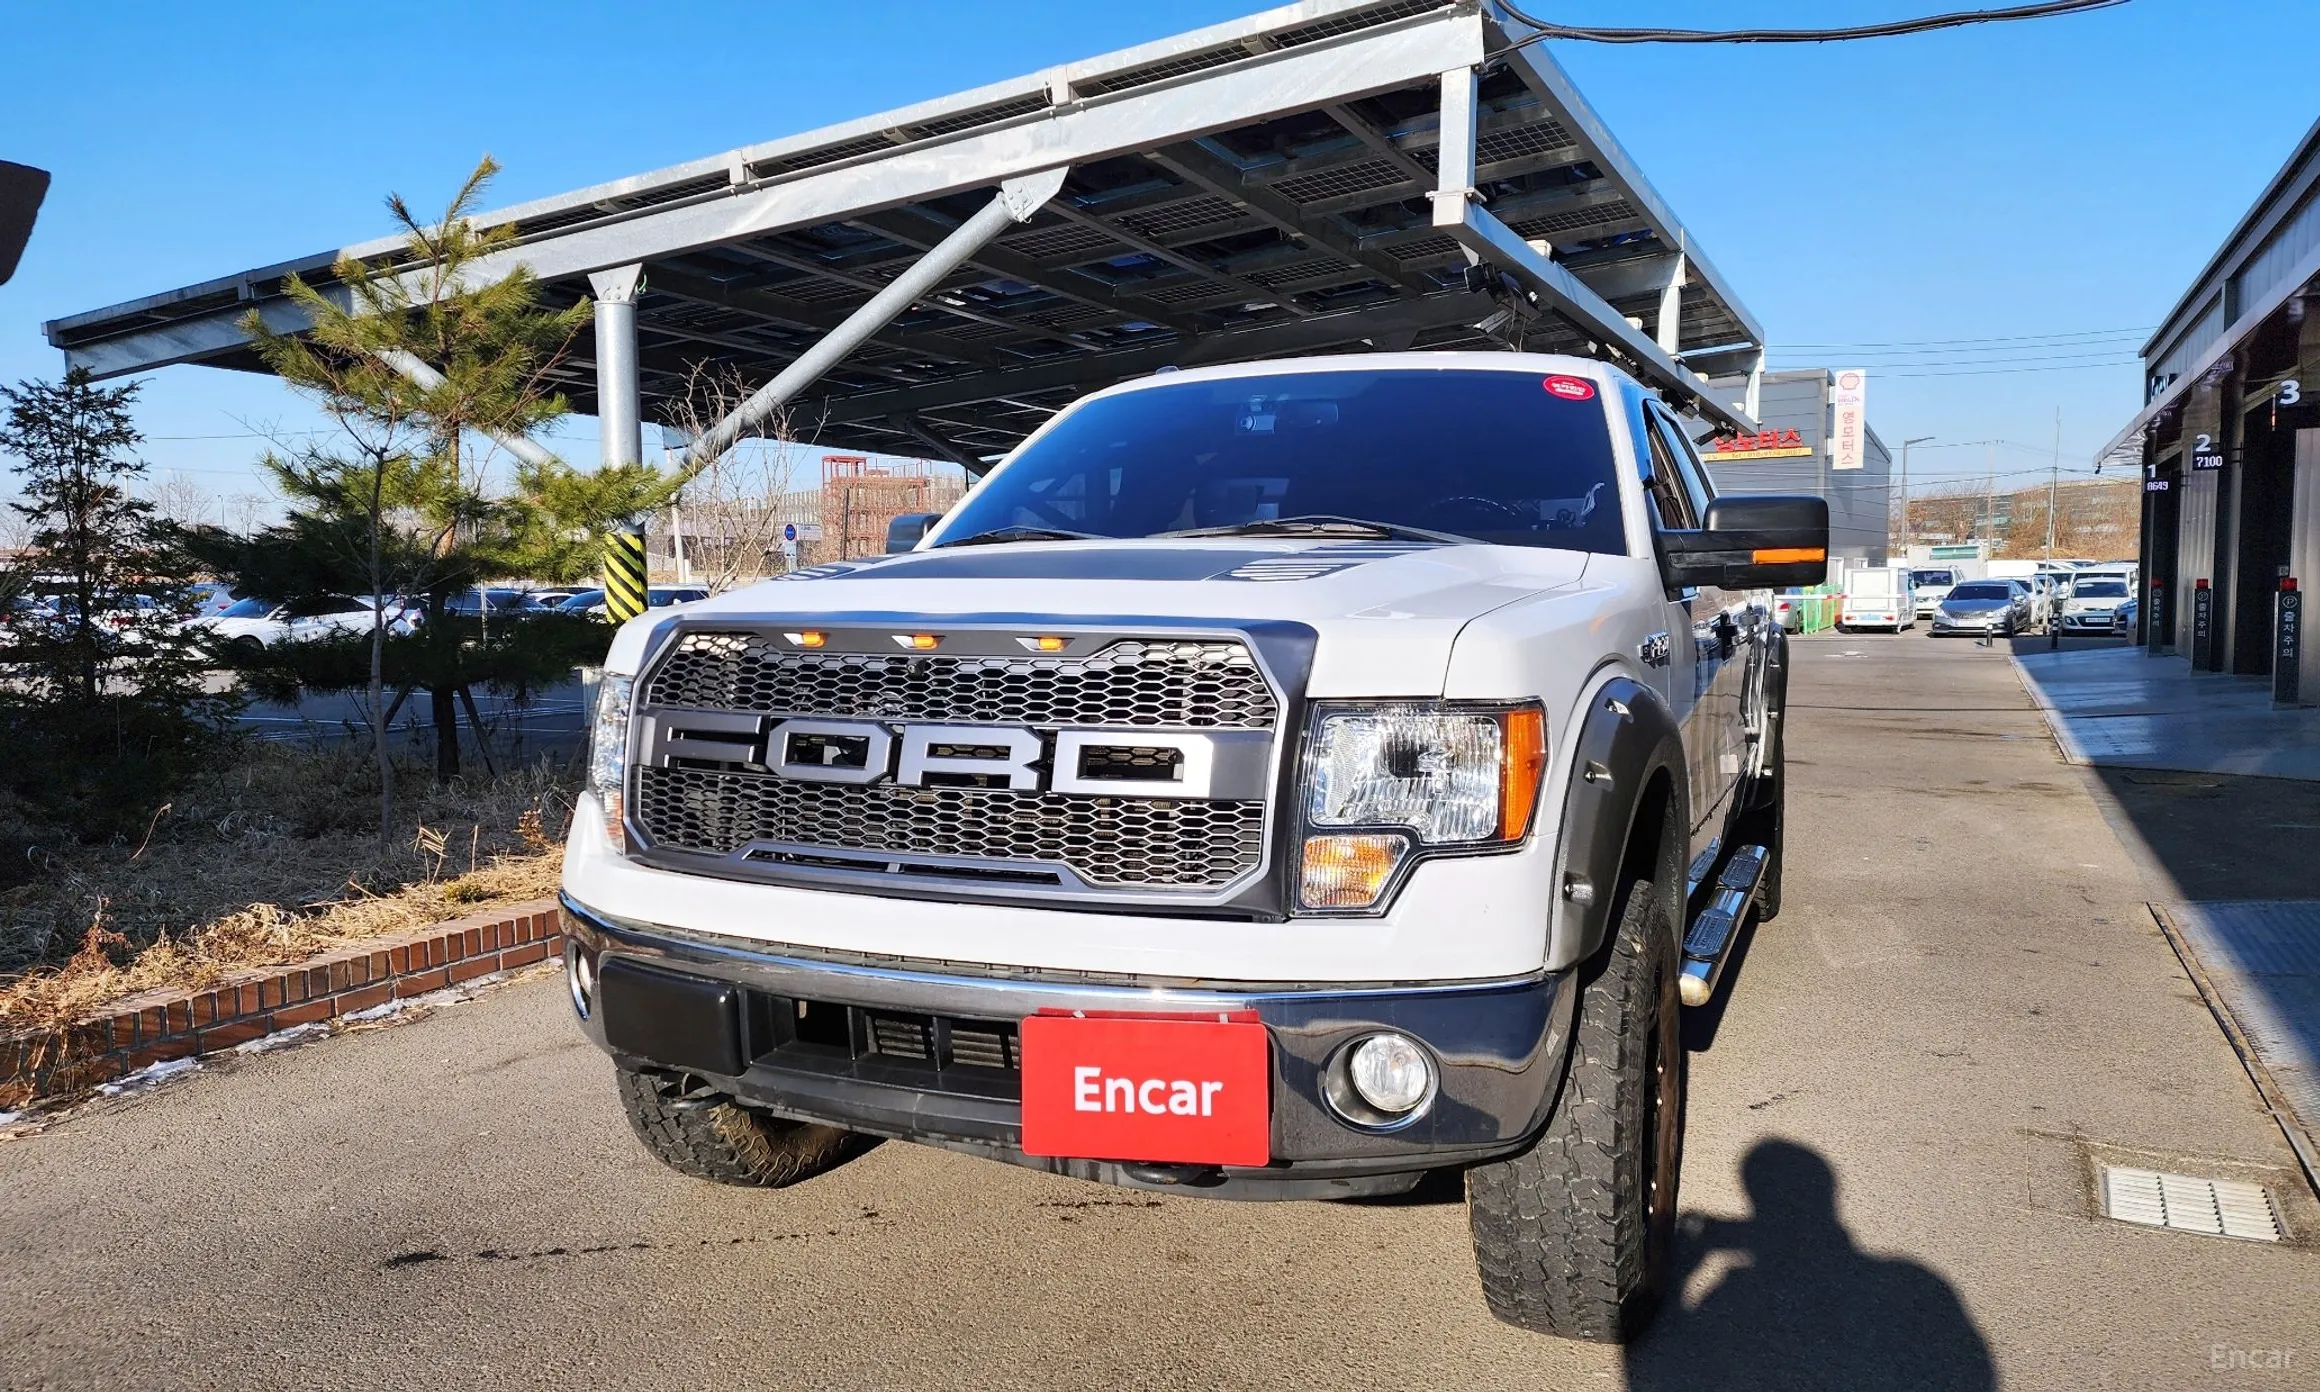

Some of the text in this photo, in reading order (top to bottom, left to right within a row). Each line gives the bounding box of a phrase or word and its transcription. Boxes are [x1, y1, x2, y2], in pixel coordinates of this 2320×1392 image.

[2279, 379, 2300, 405] 3
[1841, 411, 1856, 465] 영모터스
[2195, 434, 2211, 452] 2
[2147, 463, 2156, 478] 1
[2196, 455, 2223, 468] 7100
[2282, 611, 2295, 658] 출차주의
[652, 710, 1214, 798] FORD
[1074, 1066, 1224, 1117] Encar
